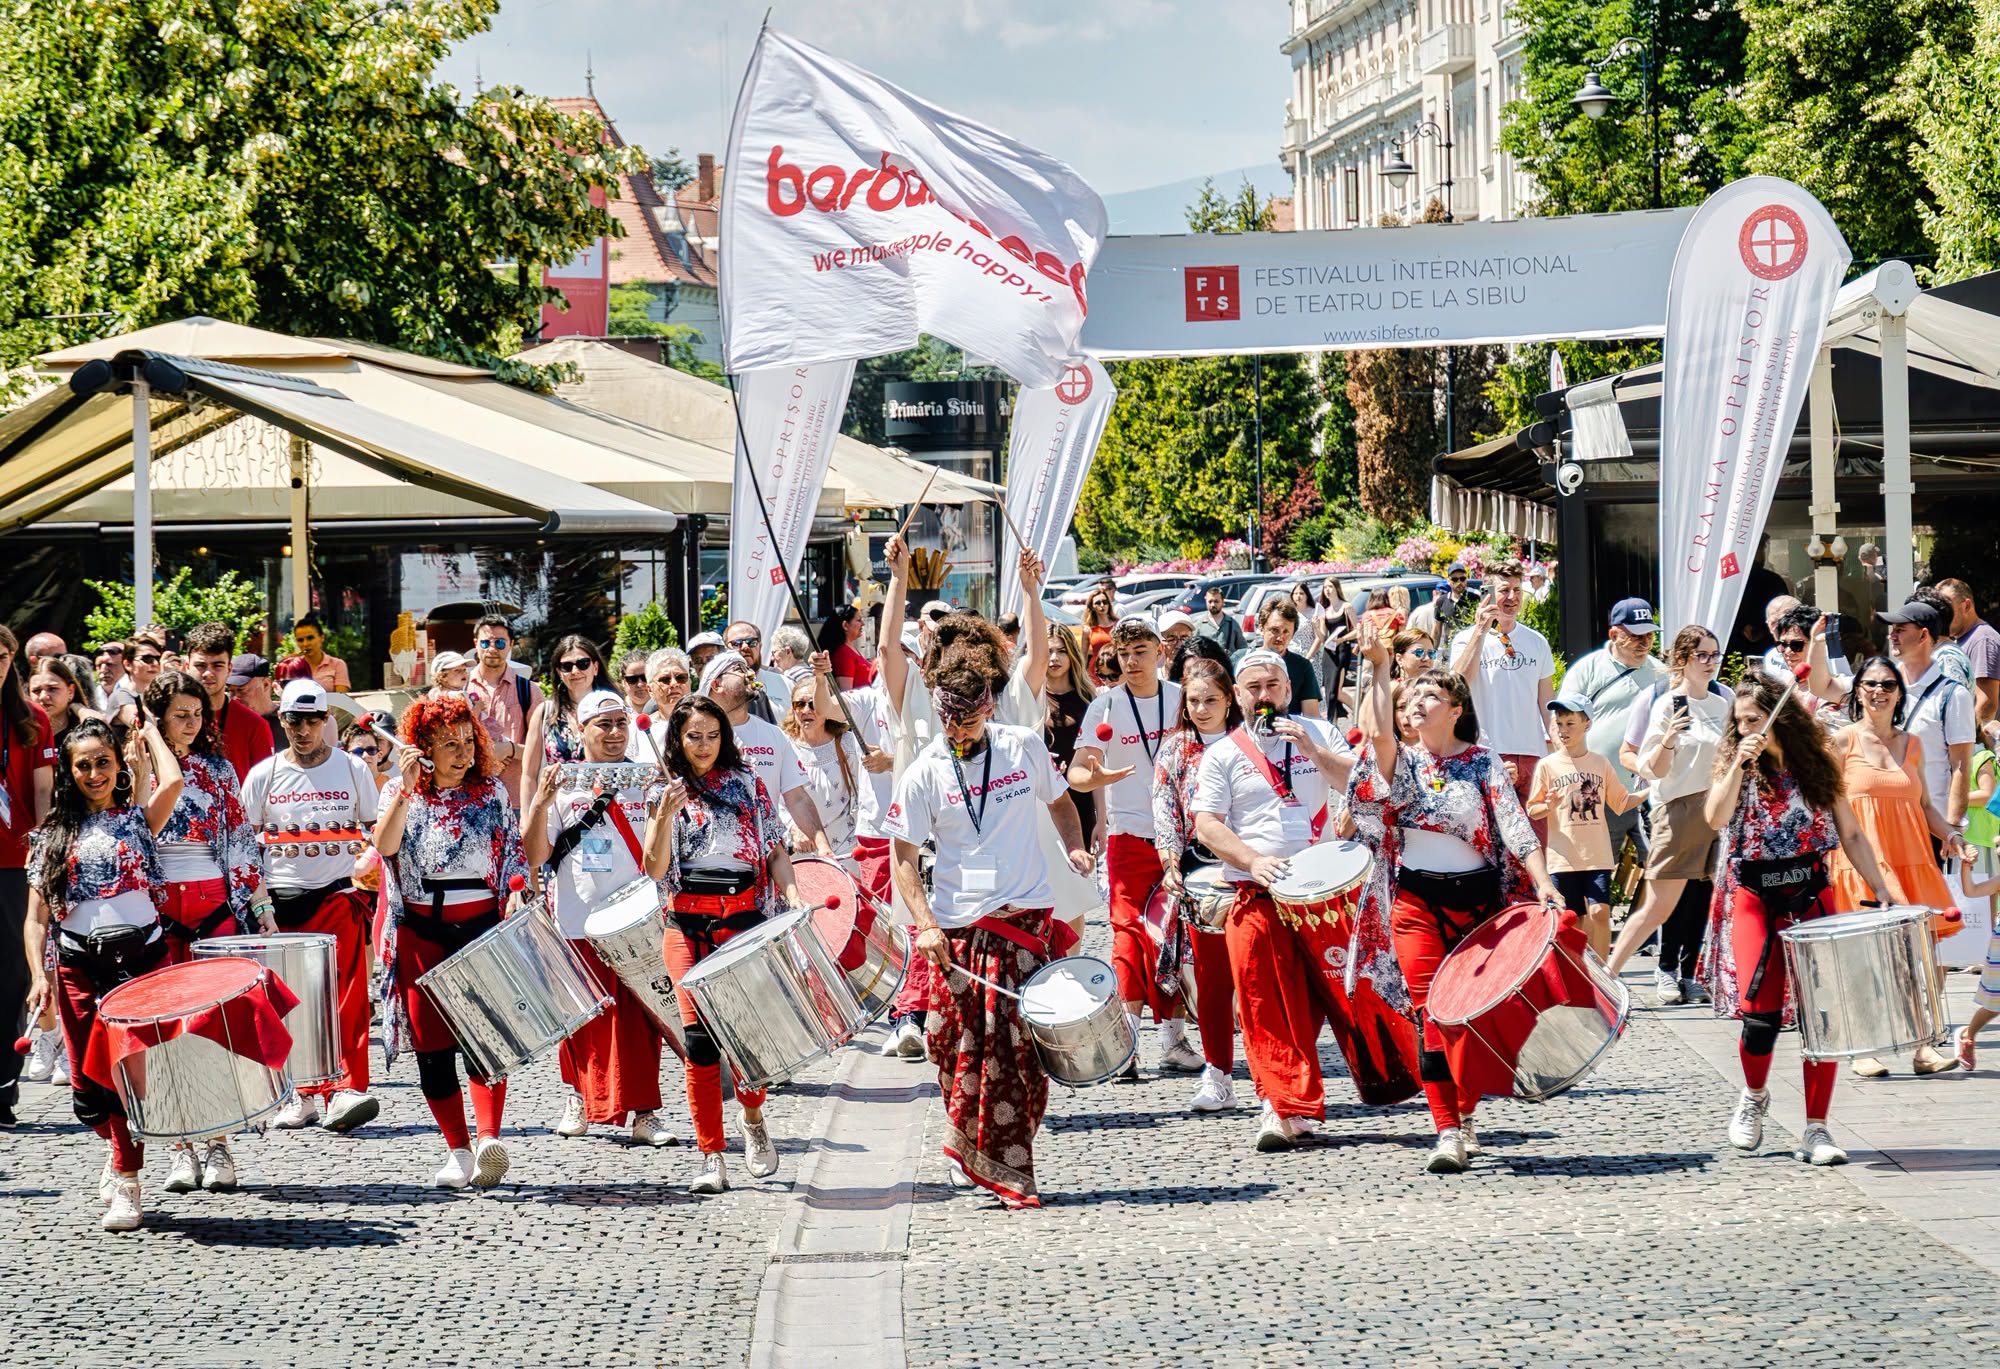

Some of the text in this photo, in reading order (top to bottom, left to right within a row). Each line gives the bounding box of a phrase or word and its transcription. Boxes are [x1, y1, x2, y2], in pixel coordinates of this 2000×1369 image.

[813, 249, 846, 272] we
[954, 240, 1053, 303] happy!
[1255, 263, 1385, 287] FESTIVALUL
[1256, 285, 1527, 316] DE TEATRU DE LA SIBIU
[1323, 323, 1441, 343] www.sibfest.ro
[1767, 336, 1783, 370] SIBIU
[1762, 374, 1774, 391] OF
[946, 397, 985, 416] Sibiu
[1749, 393, 1768, 443] WINERY
[1737, 329, 1799, 545] INTERNATIONAL THEATER FESTIVAL
[784, 485, 808, 560] INTERNATIONAL
[1687, 458, 1729, 573] CRAMA
[1554, 771, 1604, 791] DINOSAUR
[268, 790, 349, 805] barbarossa
[1761, 866, 1812, 888] READY
